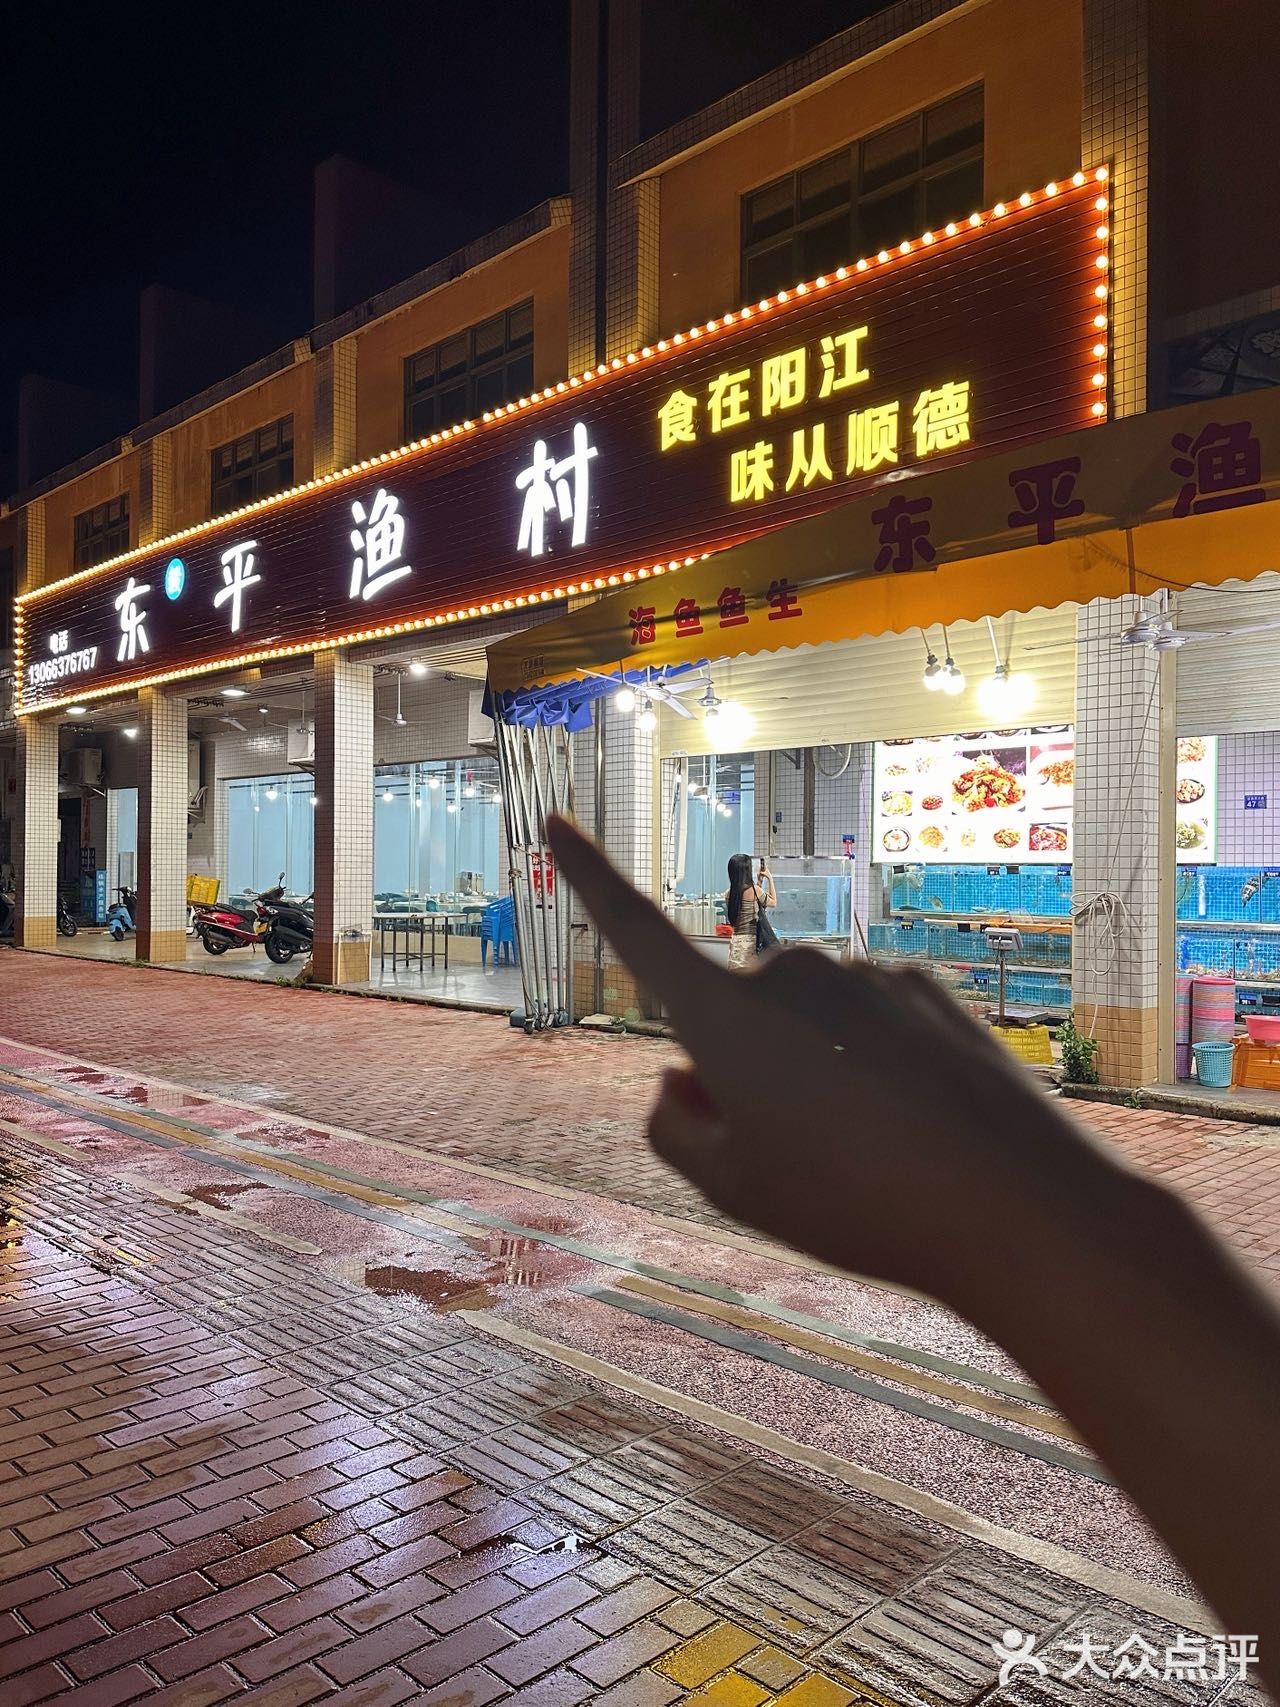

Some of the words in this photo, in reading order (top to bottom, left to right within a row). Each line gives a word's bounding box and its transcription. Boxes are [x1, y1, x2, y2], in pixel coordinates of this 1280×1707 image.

[656, 325, 871, 452] 食在阳江
[729, 381, 972, 503] 味从顺德
[28, 646, 98, 685] 13066376767
